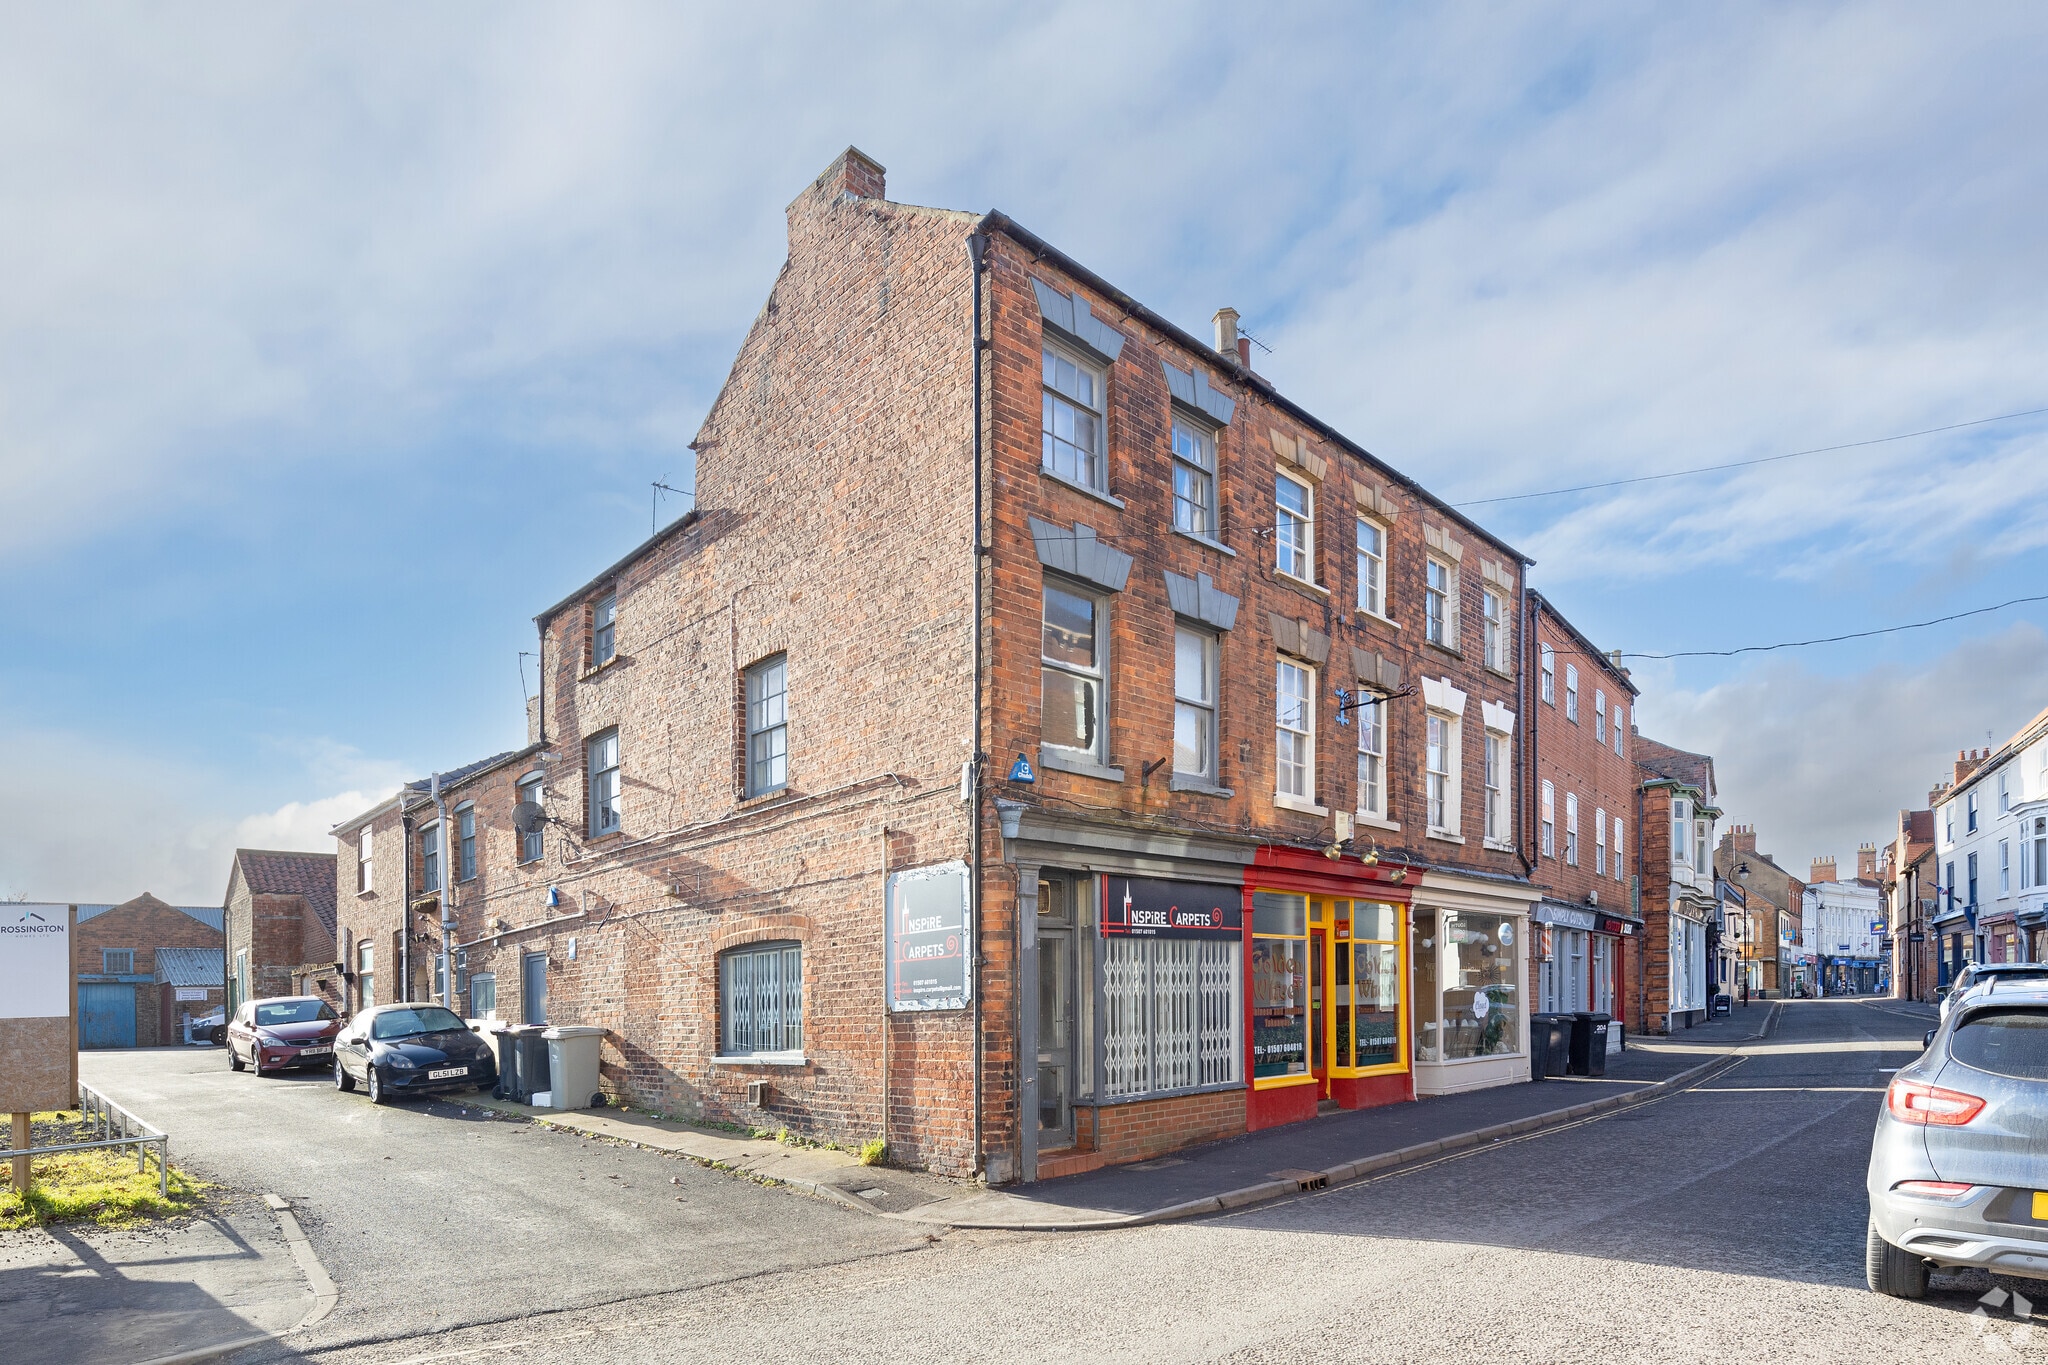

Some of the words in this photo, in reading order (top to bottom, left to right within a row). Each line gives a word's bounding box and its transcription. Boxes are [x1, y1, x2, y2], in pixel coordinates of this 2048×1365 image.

[1169, 906, 1211, 928] CARPETS
[0, 925, 64, 934] ROSSINGTON
[902, 941, 945, 961] CARPETS
[1252, 951, 1304, 975] Golden
[1267, 1044, 1283, 1053] 01507
[1283, 1043, 1303, 1052] 604819
[1369, 1037, 1382, 1045] 01507
